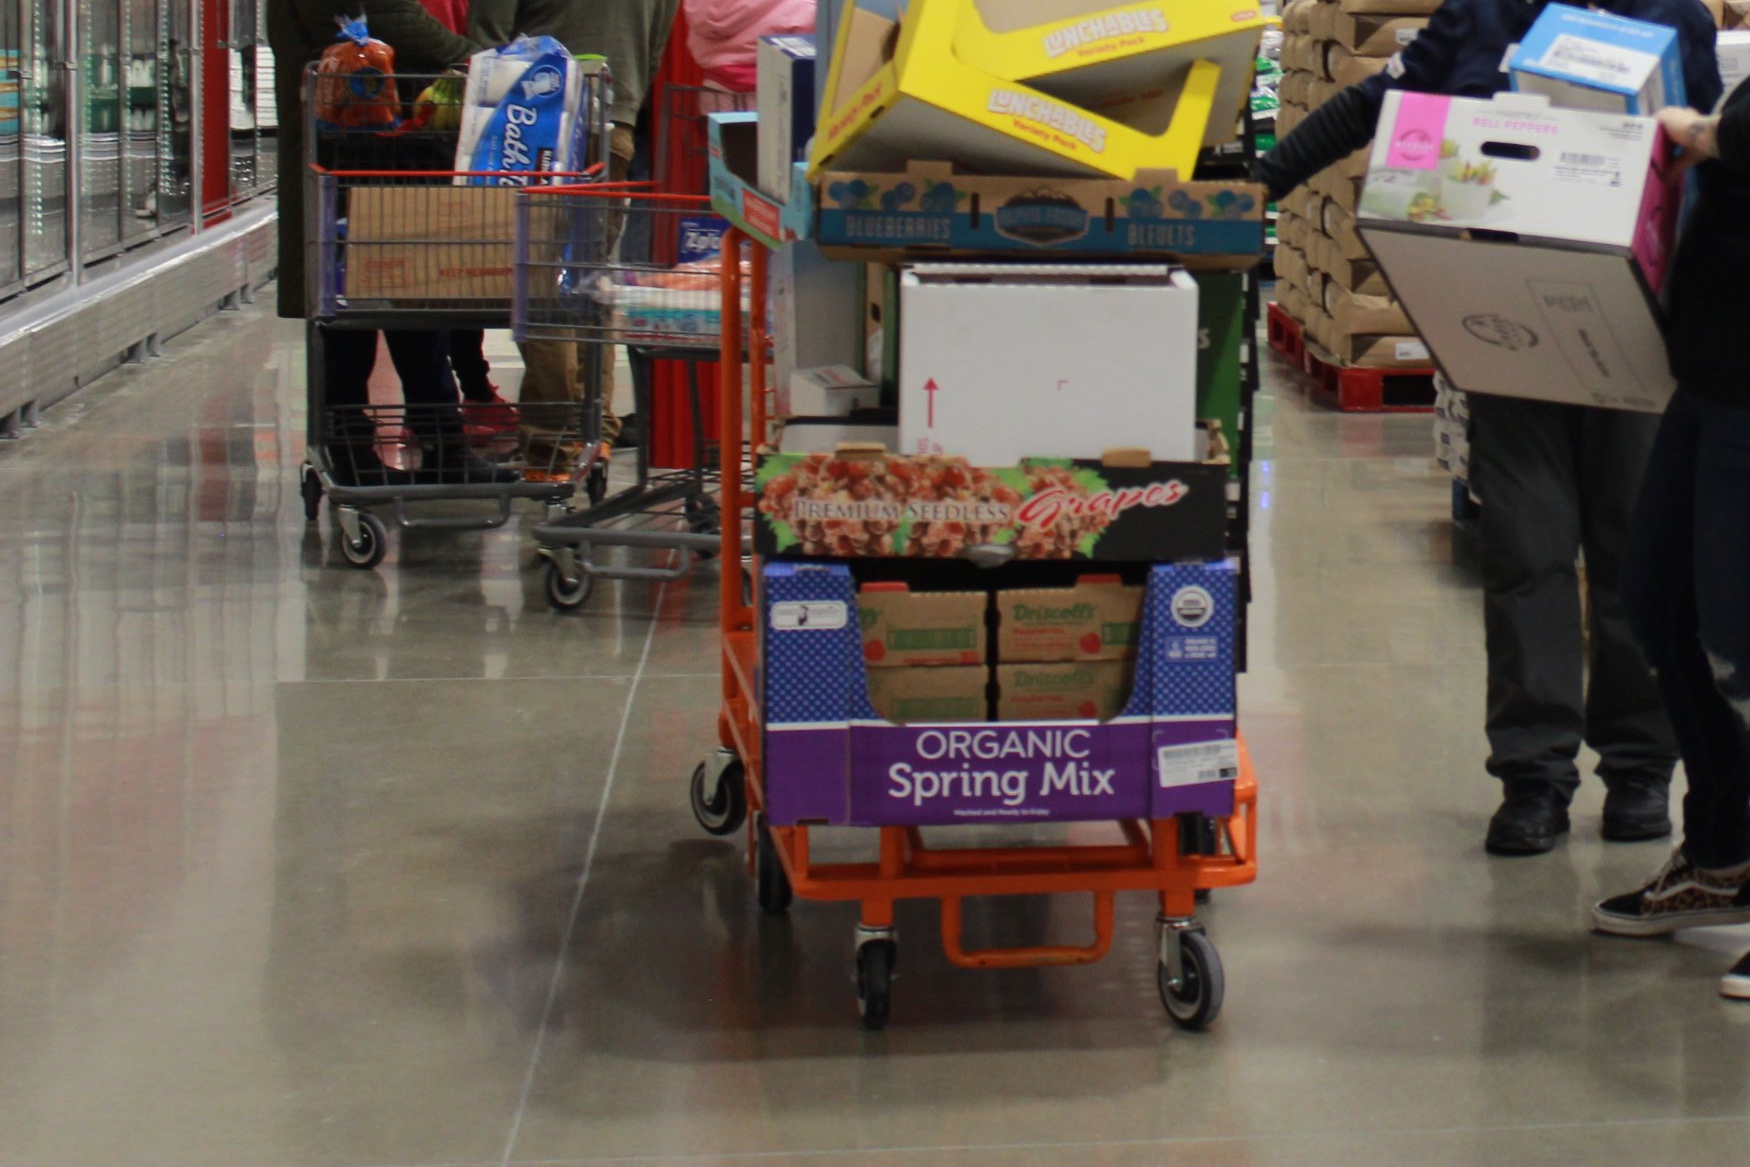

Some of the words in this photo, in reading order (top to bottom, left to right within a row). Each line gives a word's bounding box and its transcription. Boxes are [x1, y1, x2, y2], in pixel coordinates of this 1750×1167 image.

[500, 102, 539, 170] Bath
[844, 214, 953, 242] BLUEBERRIES
[1127, 222, 1196, 248] BLEUETS
[792, 499, 900, 522] PREMIUM
[907, 500, 1010, 524] SEEDLESS
[1014, 477, 1191, 531] Grapes
[915, 729, 1091, 761] ORGANIC
[887, 761, 1030, 807] Spring
[1038, 762, 1116, 796] Mix
